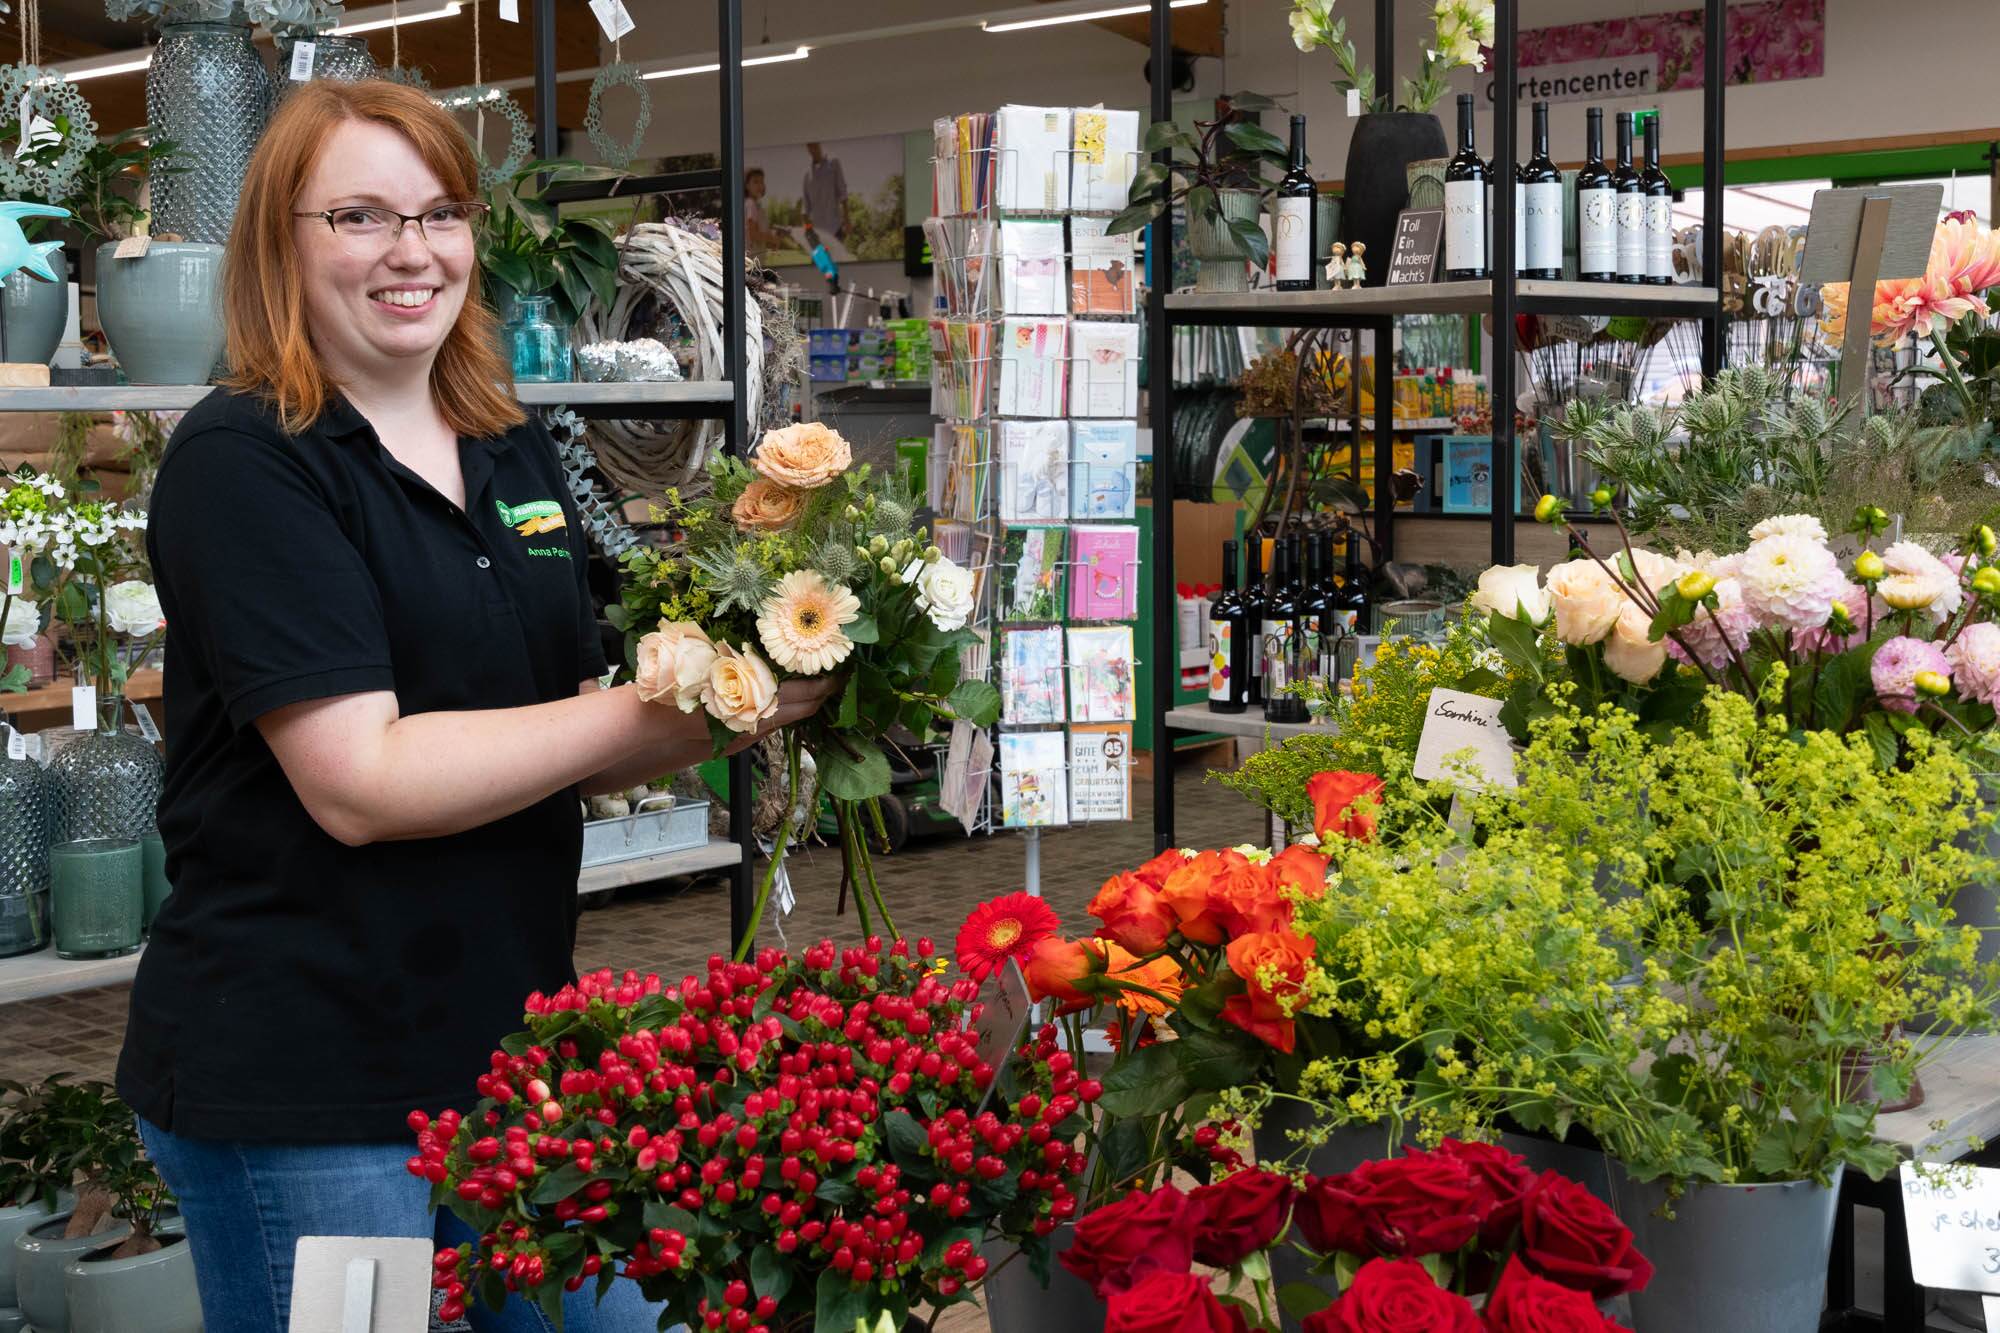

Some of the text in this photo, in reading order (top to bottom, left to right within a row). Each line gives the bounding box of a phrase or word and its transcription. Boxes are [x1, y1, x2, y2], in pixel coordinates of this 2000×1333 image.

[1486, 67, 1649, 102] Grtencenter
[1402, 218, 1421, 233] Toll
[1398, 235, 1415, 250] Ein
[1395, 252, 1432, 266] Anderer
[1391, 268, 1425, 284] Macht's
[528, 547, 552, 557] Anna
